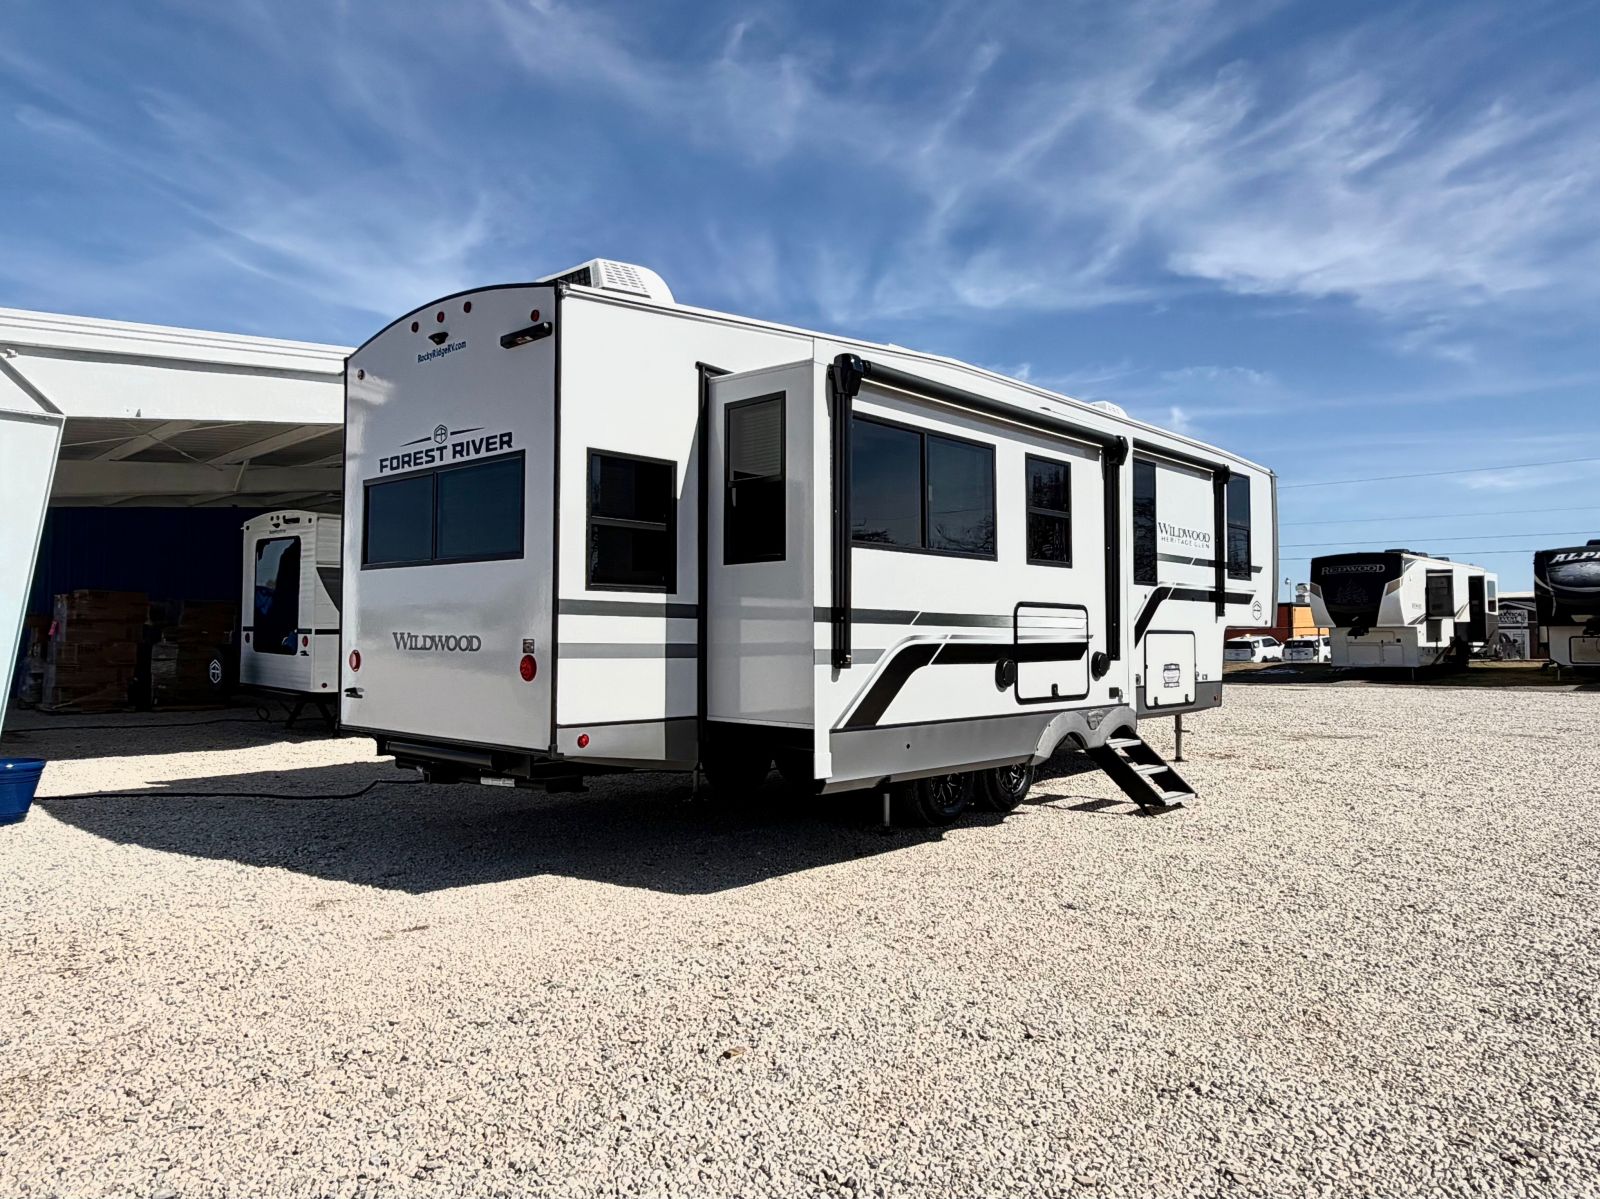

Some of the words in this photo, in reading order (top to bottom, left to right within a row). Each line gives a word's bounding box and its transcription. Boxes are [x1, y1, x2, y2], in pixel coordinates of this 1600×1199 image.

[417, 341, 467, 363] RockyRidgeRV.com
[379, 445, 448, 473] FOREST
[452, 432, 513, 459] RIVER
[1158, 522, 1210, 543] WILDWOOD
[1161, 537, 1192, 546] HERITAGE
[1321, 564, 1386, 575] REDWOOD
[392, 631, 482, 652] WILDWOOD
